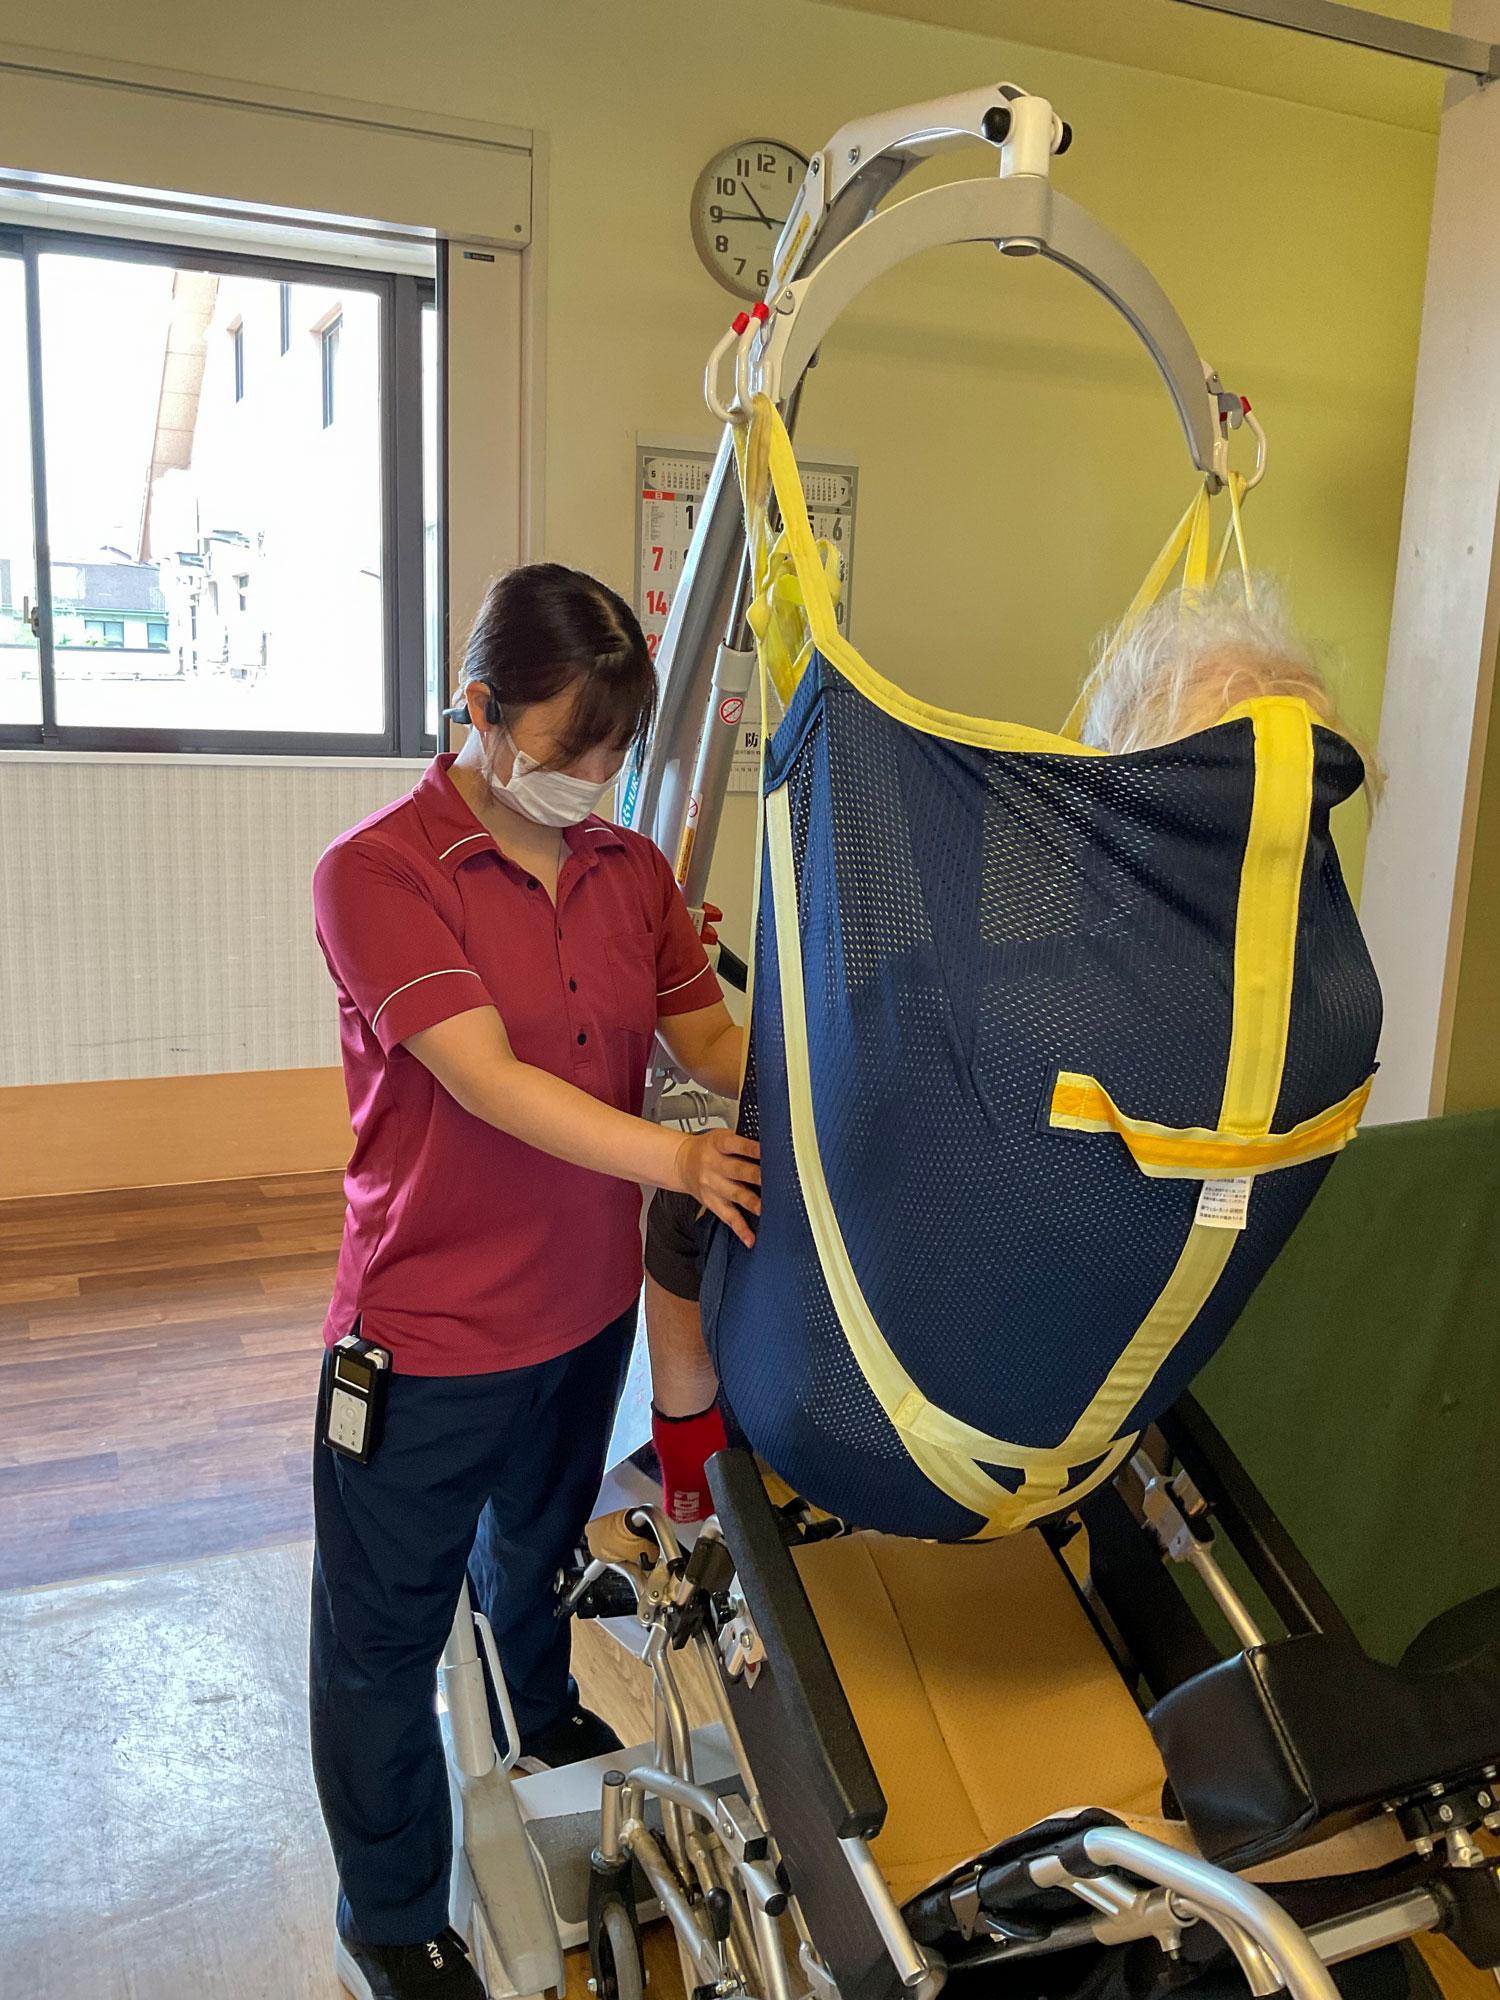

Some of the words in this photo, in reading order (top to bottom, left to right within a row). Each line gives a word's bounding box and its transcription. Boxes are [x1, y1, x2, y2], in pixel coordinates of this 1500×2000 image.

[736, 158, 750, 178] 11
[757, 153, 776, 174] 12
[787, 165, 793, 184] 1
[716, 176, 736, 196] 10
[709, 205, 723, 223] 9
[715, 235, 729, 253] 8
[733, 257, 747, 275] 7
[756, 269, 770, 287] 6
[651, 470, 657, 478] 5
[840, 487, 846, 495] 7
[685, 505, 694, 530] 1
[832, 517, 843, 542] 6
[651, 546, 664, 572] 7
[646, 590, 668, 616] 14
[646, 633, 663, 659] 2
